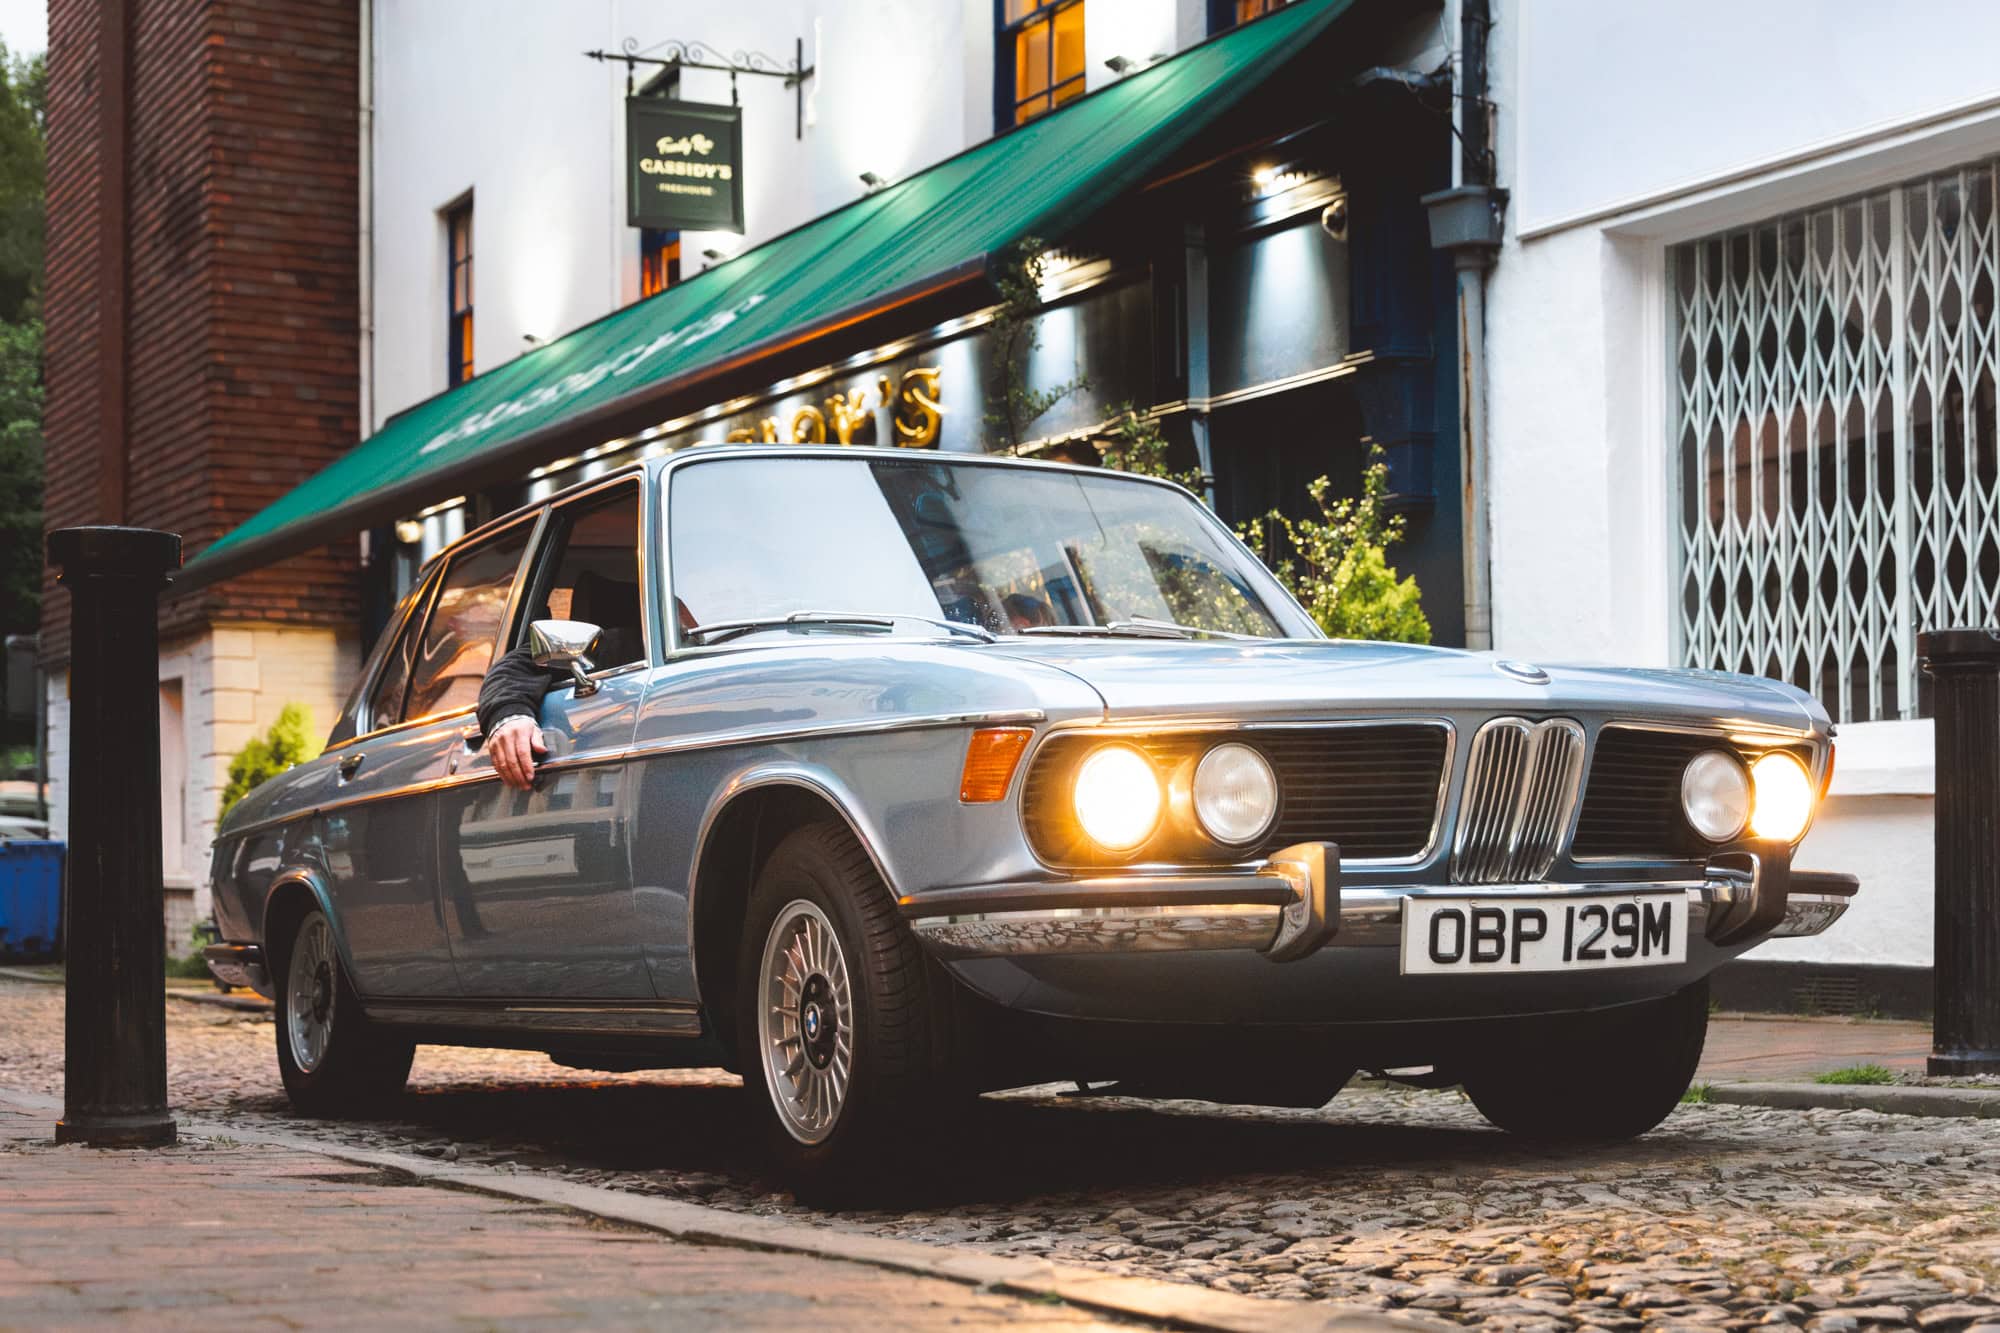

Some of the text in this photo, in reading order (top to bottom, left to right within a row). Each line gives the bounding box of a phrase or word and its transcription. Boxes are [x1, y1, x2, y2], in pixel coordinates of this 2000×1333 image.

[640, 158, 732, 180] CASSIDY'S
[1428, 901, 1672, 965] OBP 129M
